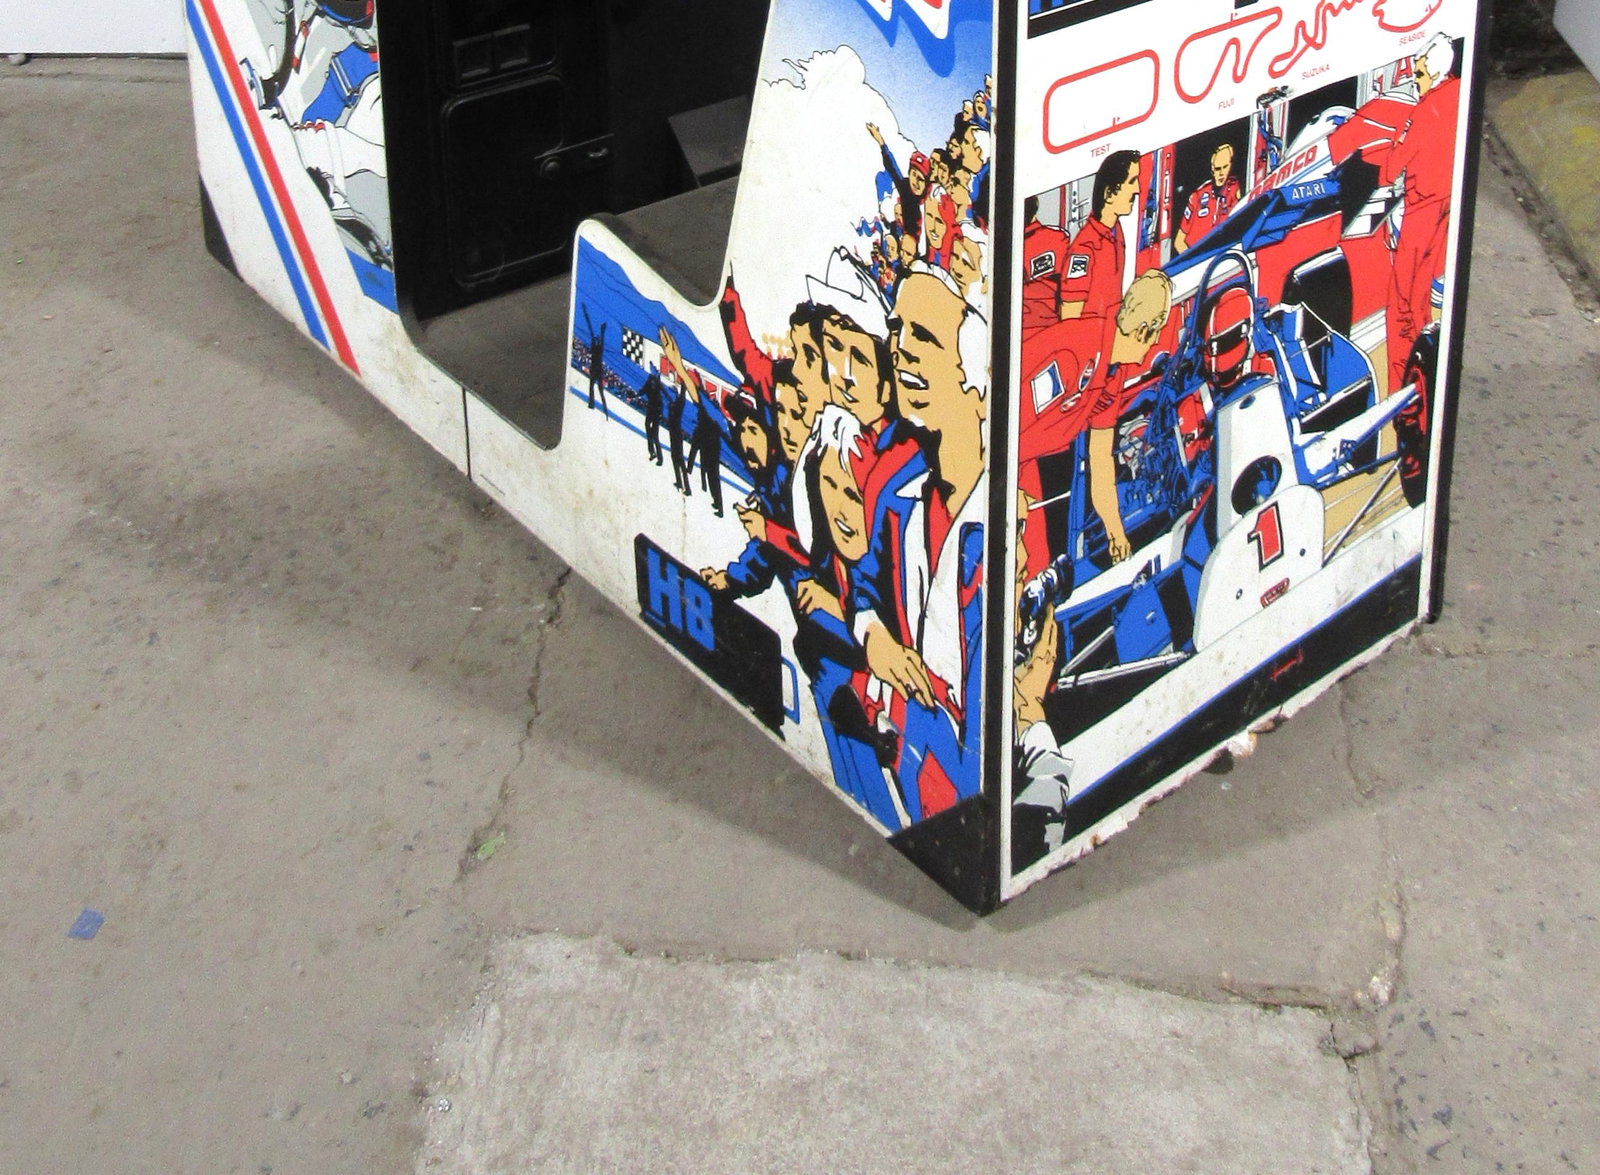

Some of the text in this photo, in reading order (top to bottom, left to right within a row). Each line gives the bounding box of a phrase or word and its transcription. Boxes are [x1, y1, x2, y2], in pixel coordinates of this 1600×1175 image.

[1399, 30, 1426, 46] SEASIDE
[1301, 64, 1330, 80] SUZUKA
[1218, 97, 1235, 110] FUJI
[1090, 143, 1111, 158] TEST
[1292, 182, 1326, 200] ATARI
[1247, 501, 1284, 573] 1
